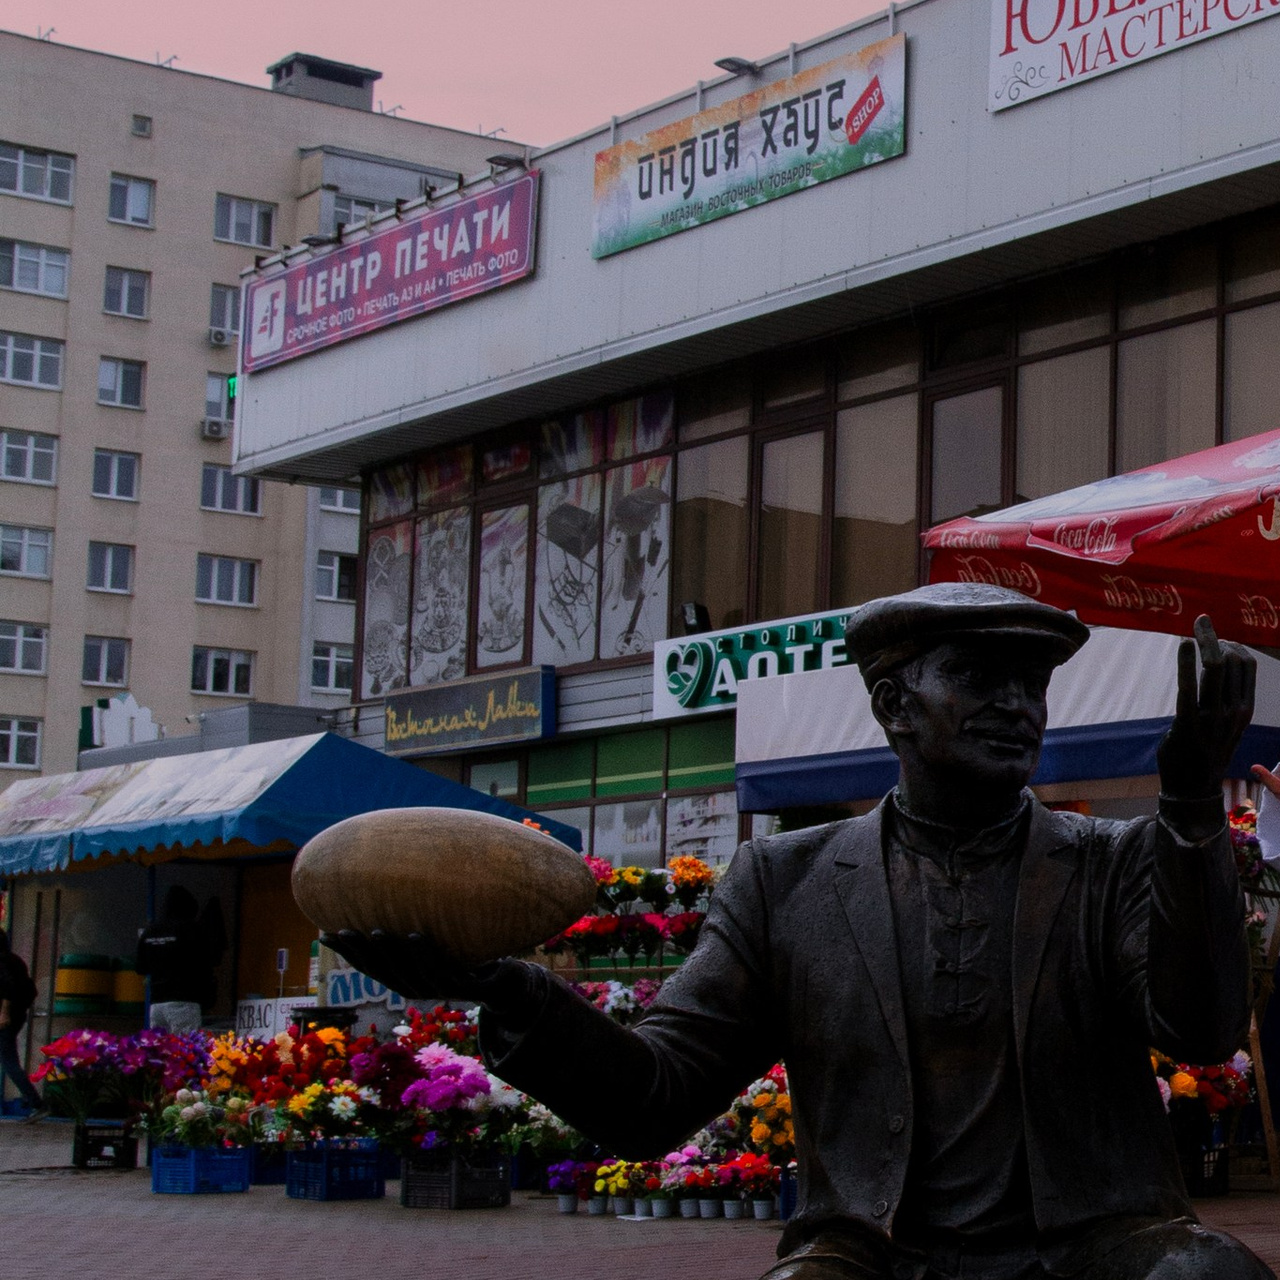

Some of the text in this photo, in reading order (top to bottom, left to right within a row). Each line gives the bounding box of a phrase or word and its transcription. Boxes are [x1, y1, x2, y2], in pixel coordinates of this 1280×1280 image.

[851, 85, 881, 133] SHOP
[660, 162, 812, 227] МАГАЗИН ВОСТОЧНЫХ ТОВАРОВ
[295, 200, 511, 317] ЦЕНТР ПЕЧАТИ
[287, 318, 328, 344] СРОЧНОЕ
[329, 308, 355, 329] ФОТО
[363, 296, 400, 317] ПЕЧАТЬ
[446, 262, 487, 288] ПЕЧАТЬ
[488, 248, 519, 271] ФОТО
[237, 1003, 272, 1030] КВАС
